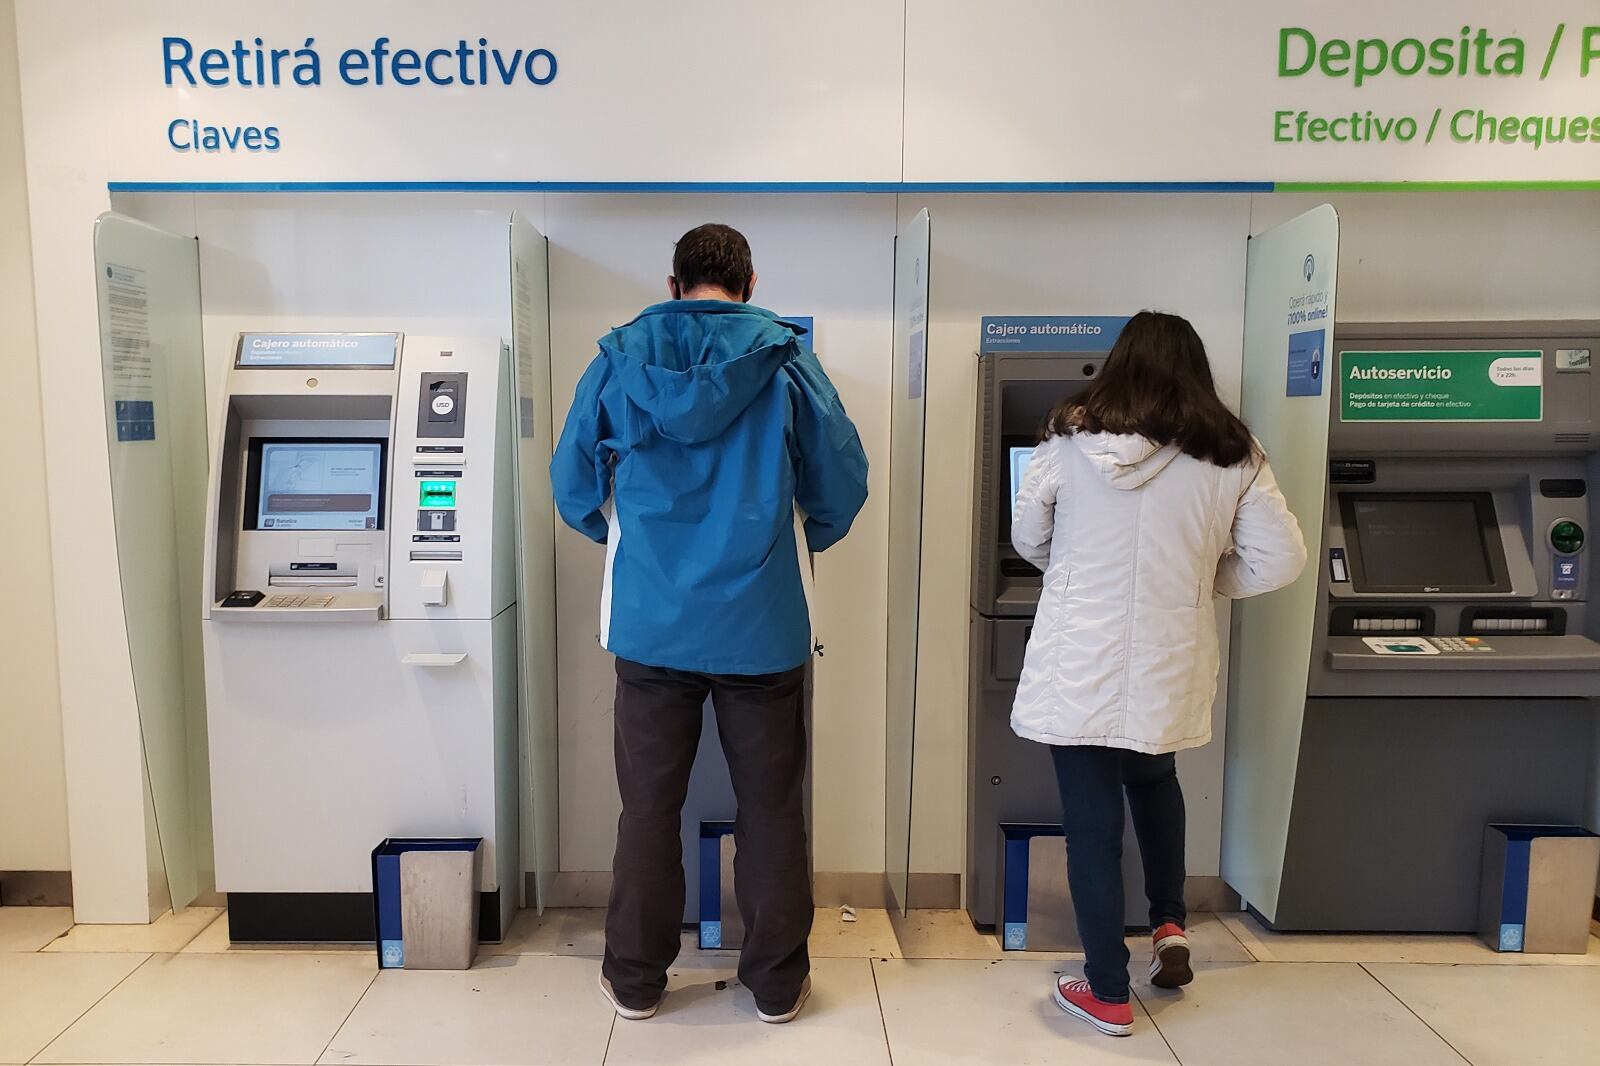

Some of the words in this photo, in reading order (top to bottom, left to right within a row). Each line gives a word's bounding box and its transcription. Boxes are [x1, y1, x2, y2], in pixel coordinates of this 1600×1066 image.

[162, 36, 321, 87] Retirá
[339, 37, 558, 86] efectivo
[1278, 26, 1525, 88] Deposita
[1539, 23, 1565, 81] /
[168, 118, 281, 152] Claves
[1273, 110, 1417, 143] Efectivo
[1424, 107, 1442, 145] /
[1450, 108, 1600, 151] Cheques
[1307, 304, 1328, 321] online!
[986, 322, 1028, 337] Cajero
[1029, 322, 1102, 335] automático
[252, 338, 290, 350] Cajero
[291, 337, 359, 348] automático
[1349, 365, 1452, 380] Autoservicio
[1349, 392, 1383, 400] Depósitos
[1393, 392, 1419, 400] efectivo
[1419, 393, 1425, 401] y
[1425, 392, 1450, 401] cheque
[1349, 400, 1366, 409] Pago
[1377, 400, 1400, 409] tarjeta
